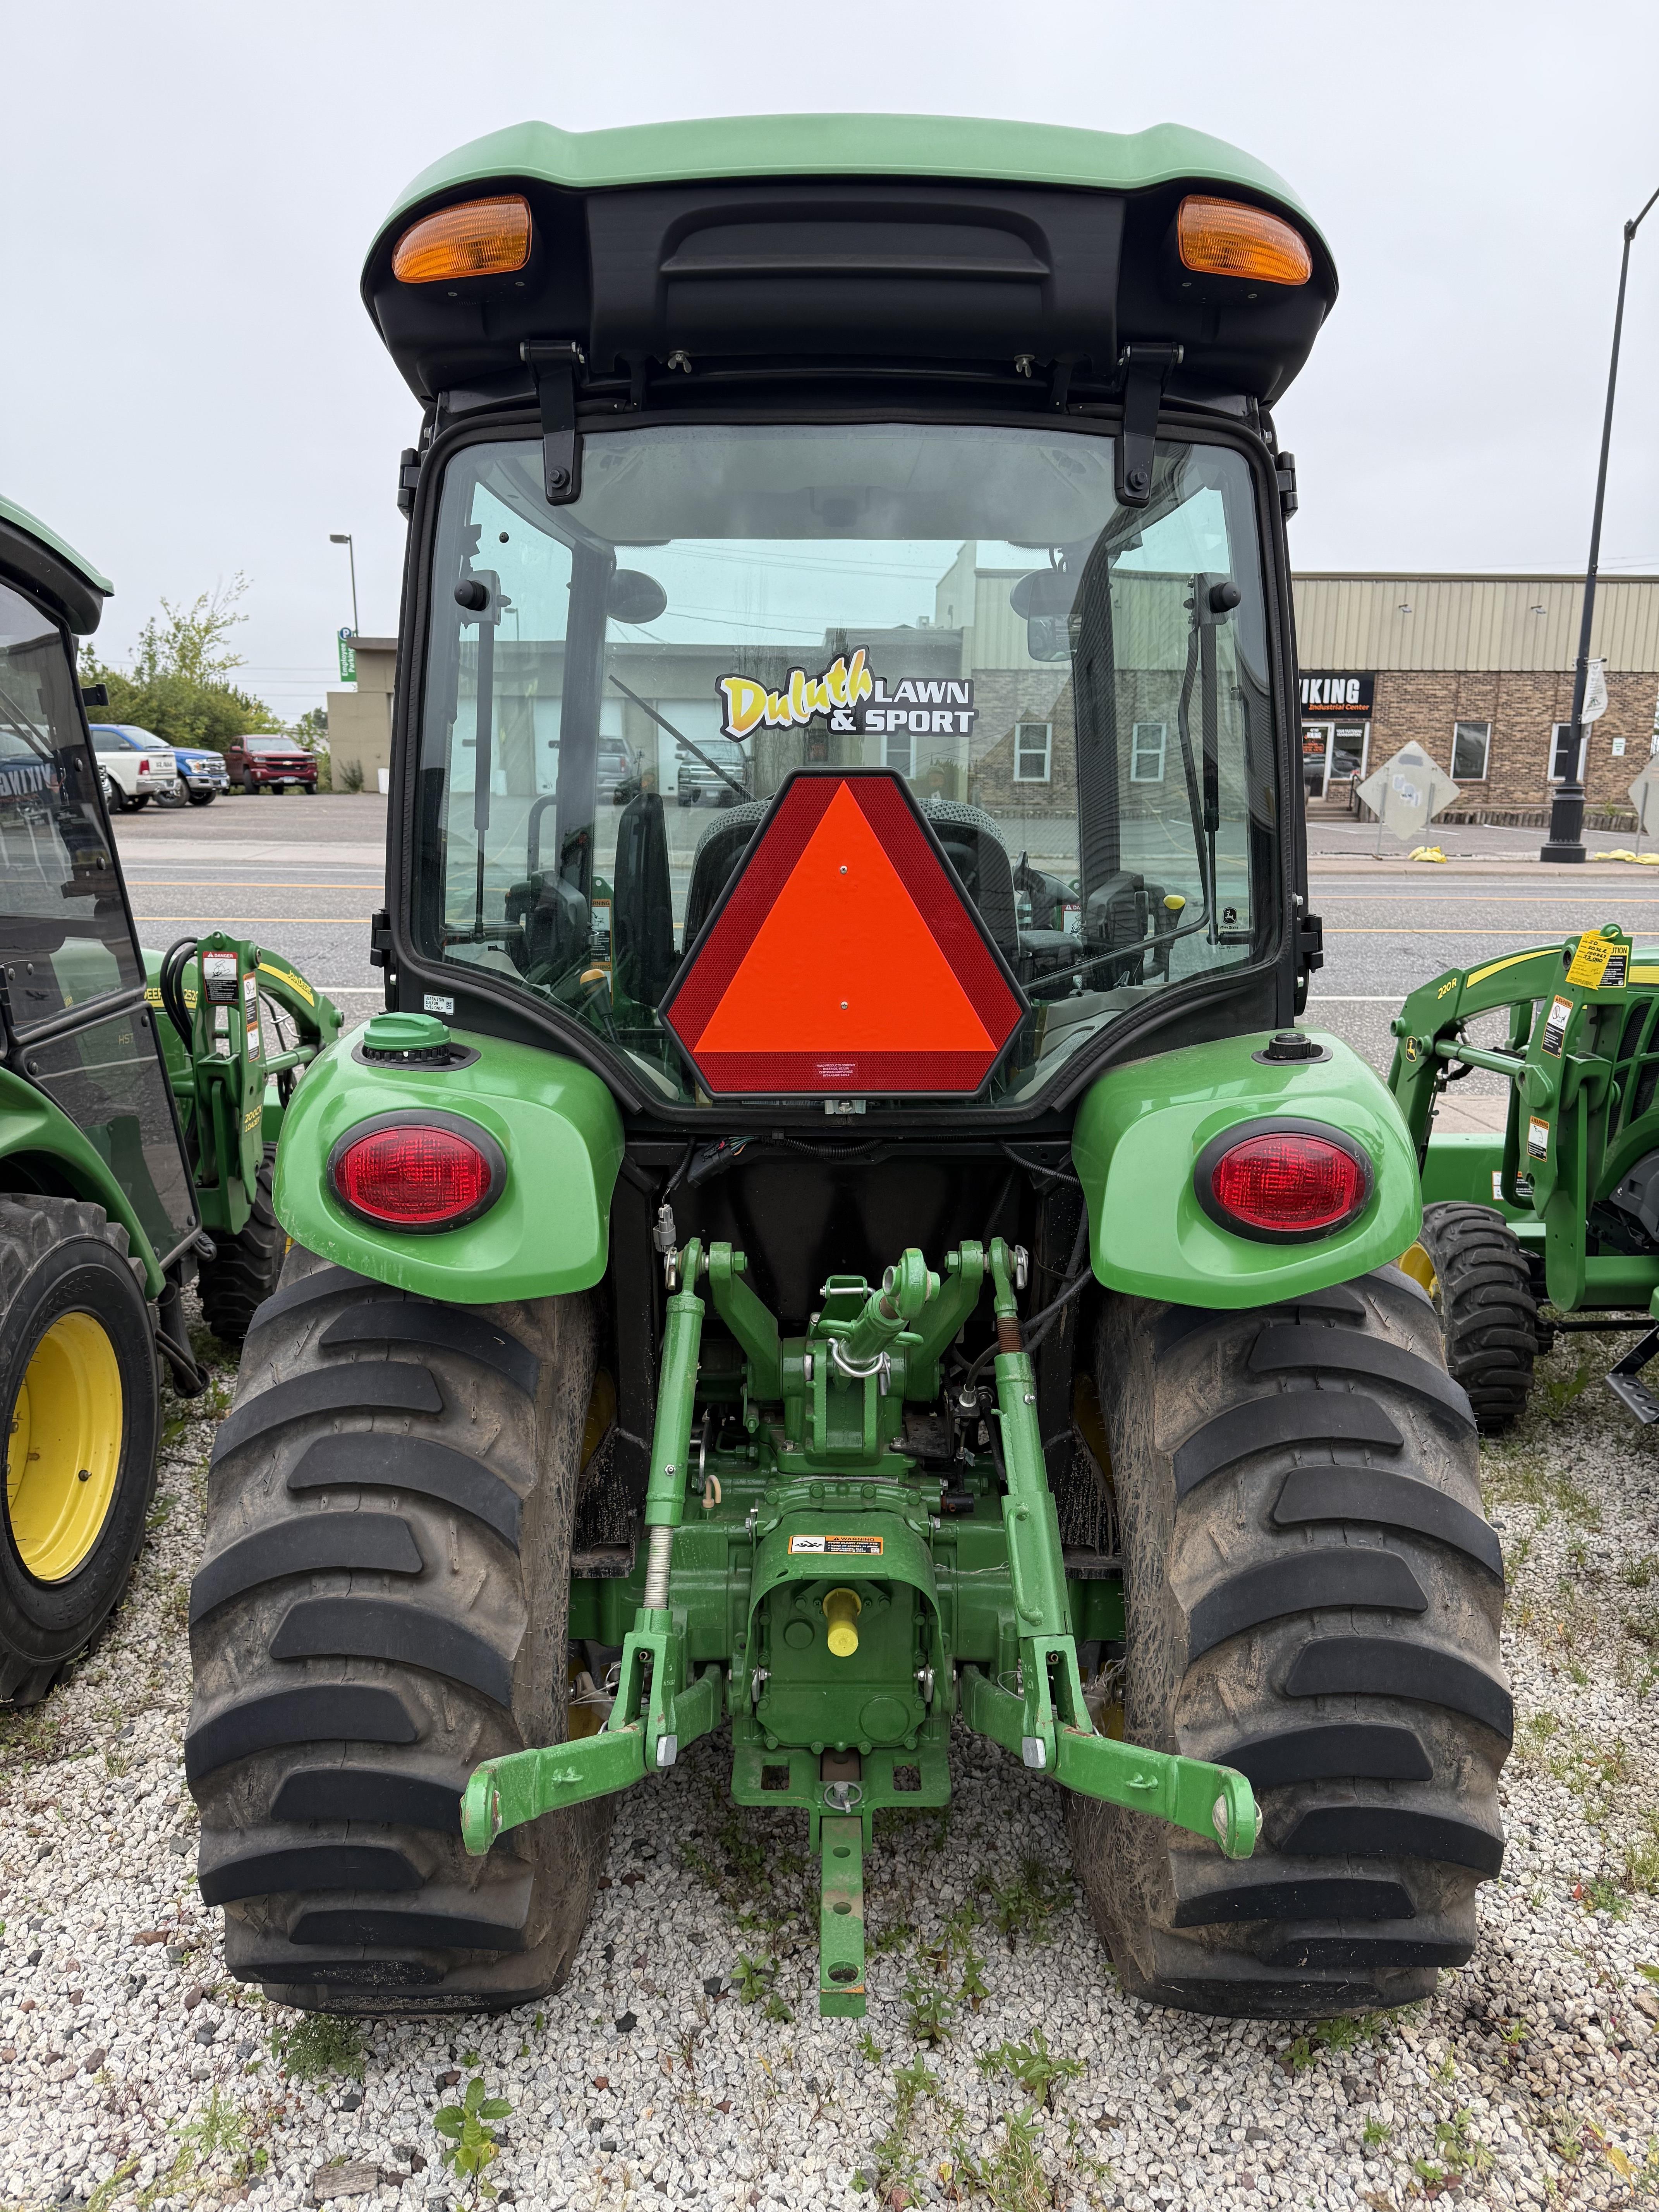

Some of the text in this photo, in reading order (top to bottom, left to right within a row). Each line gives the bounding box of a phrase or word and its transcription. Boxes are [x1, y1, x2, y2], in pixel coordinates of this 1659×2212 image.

[721, 649, 969, 738] Duluth LAWN
[831, 709, 974, 733] & SPORT
[119, 1033, 134, 1044] HST
[245, 1116, 260, 1132] LOADER
